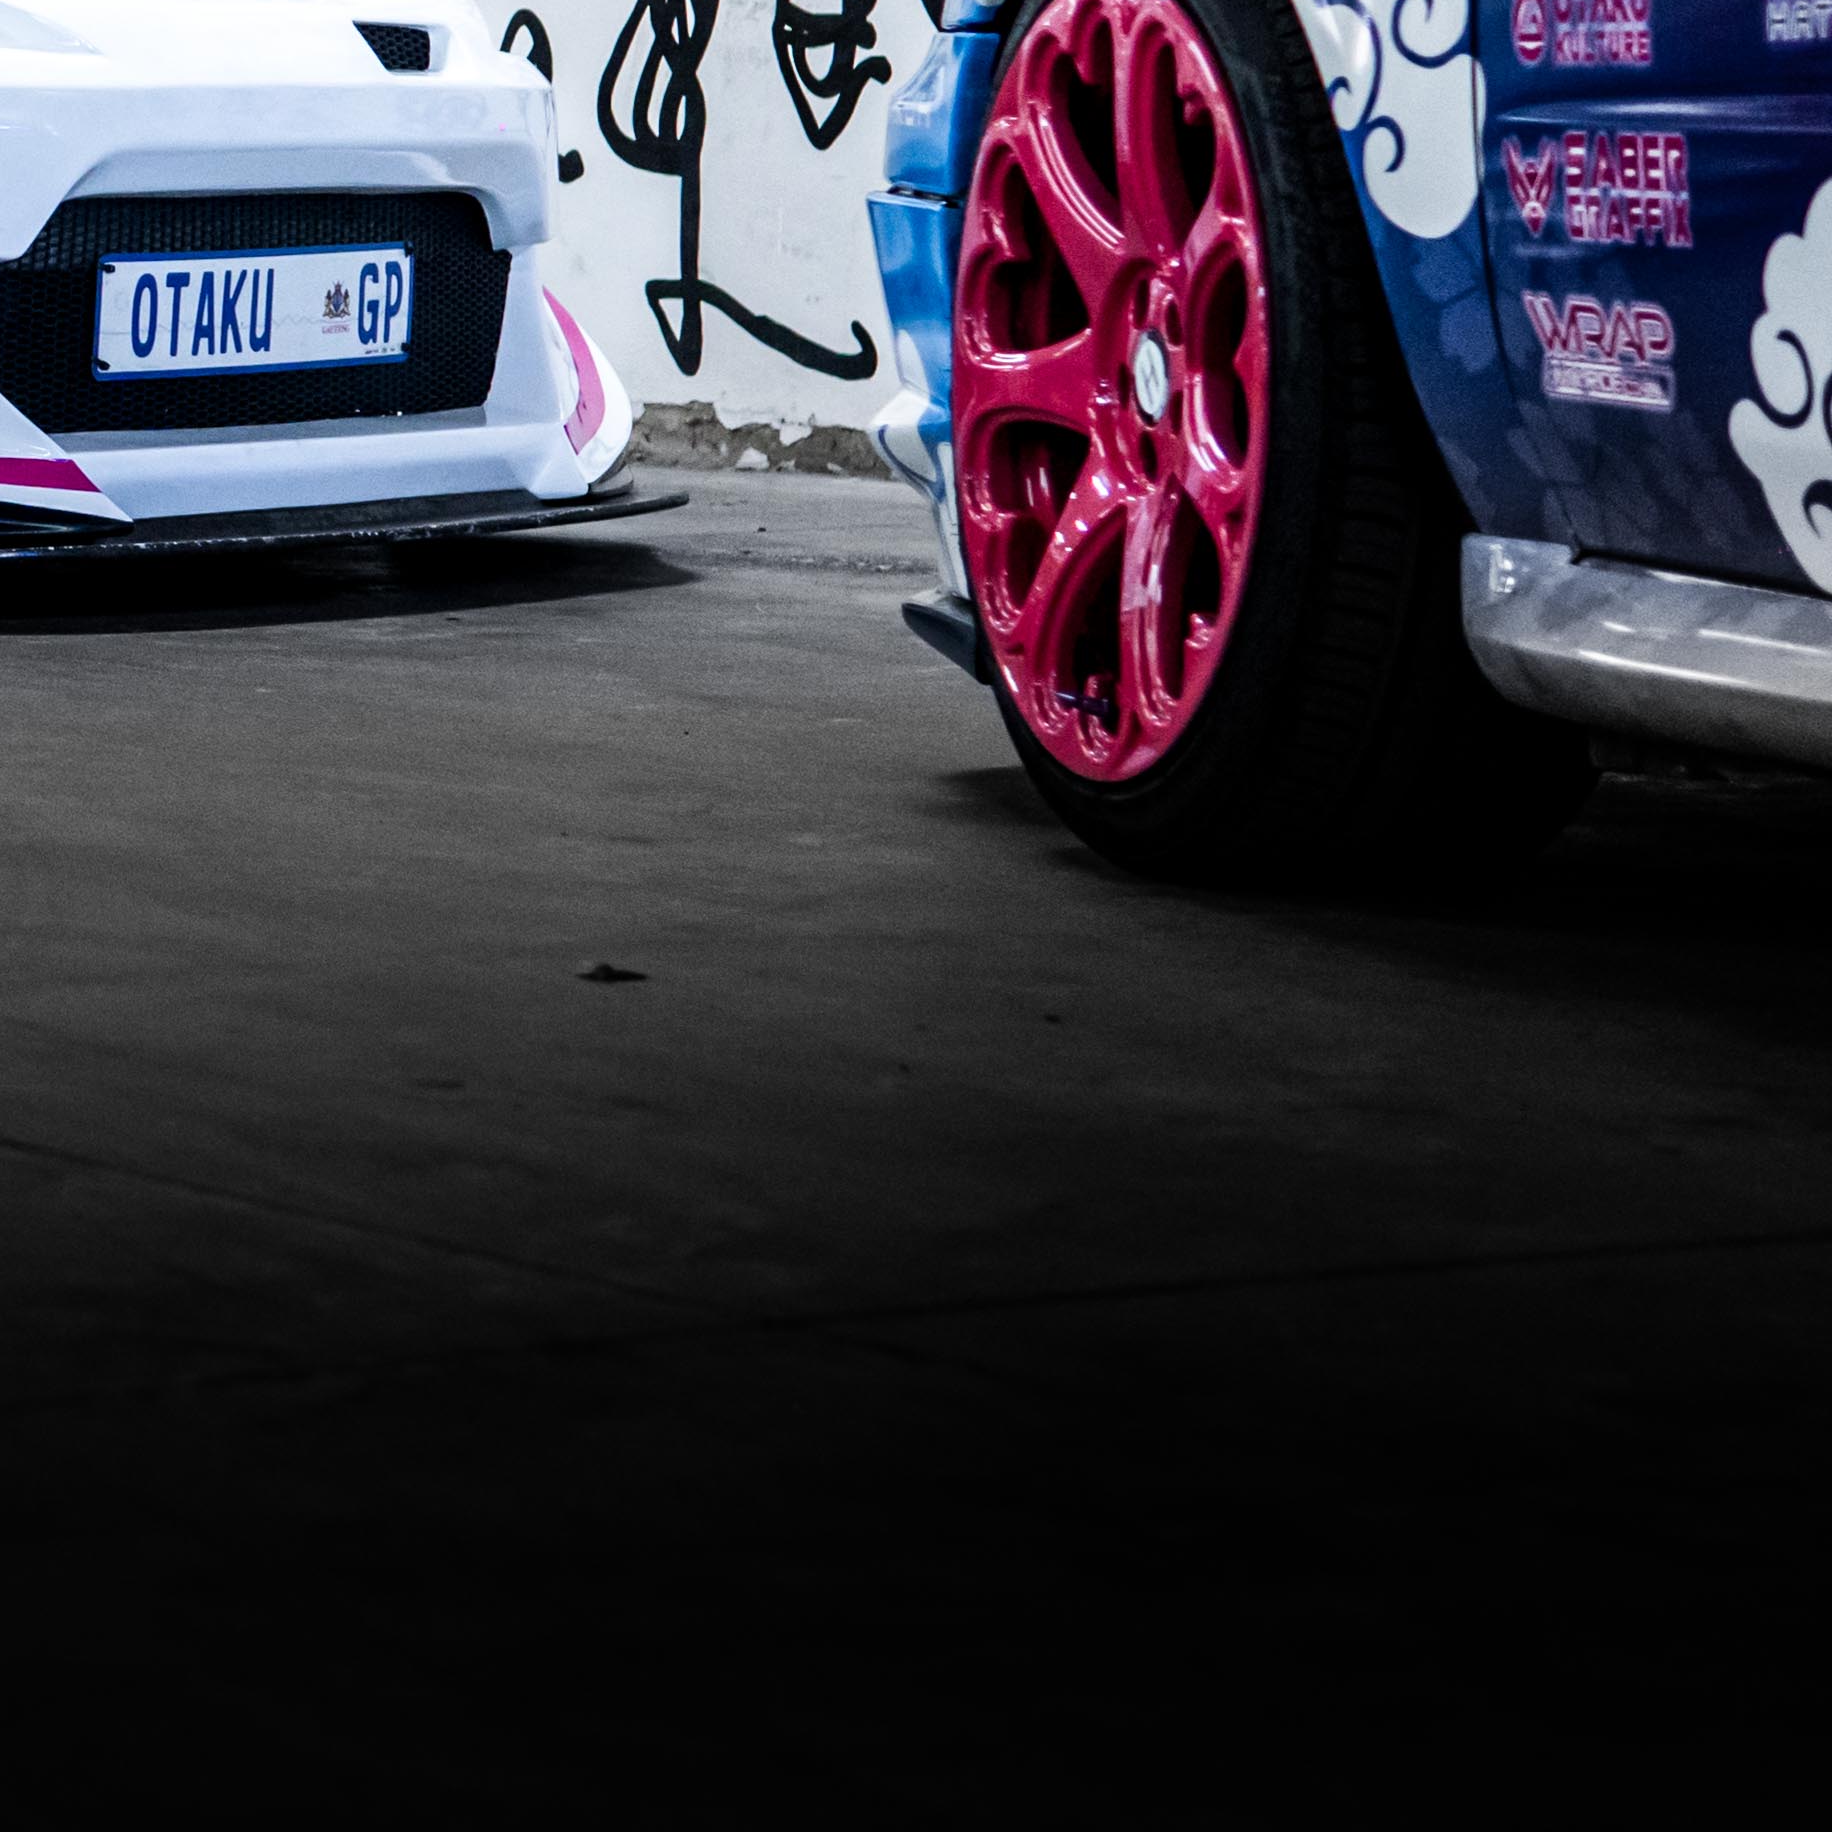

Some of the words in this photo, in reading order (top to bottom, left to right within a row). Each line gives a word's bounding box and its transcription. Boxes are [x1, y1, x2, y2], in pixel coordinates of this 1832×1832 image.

[1555, 22, 1652, 65] KULTURE
[1564, 132, 1688, 191] SABER
[1565, 193, 1693, 247] GRAFFIX
[131, 268, 274, 358] OTAKU
[357, 261, 403, 345] GP
[1522, 291, 1674, 361] WRAP
